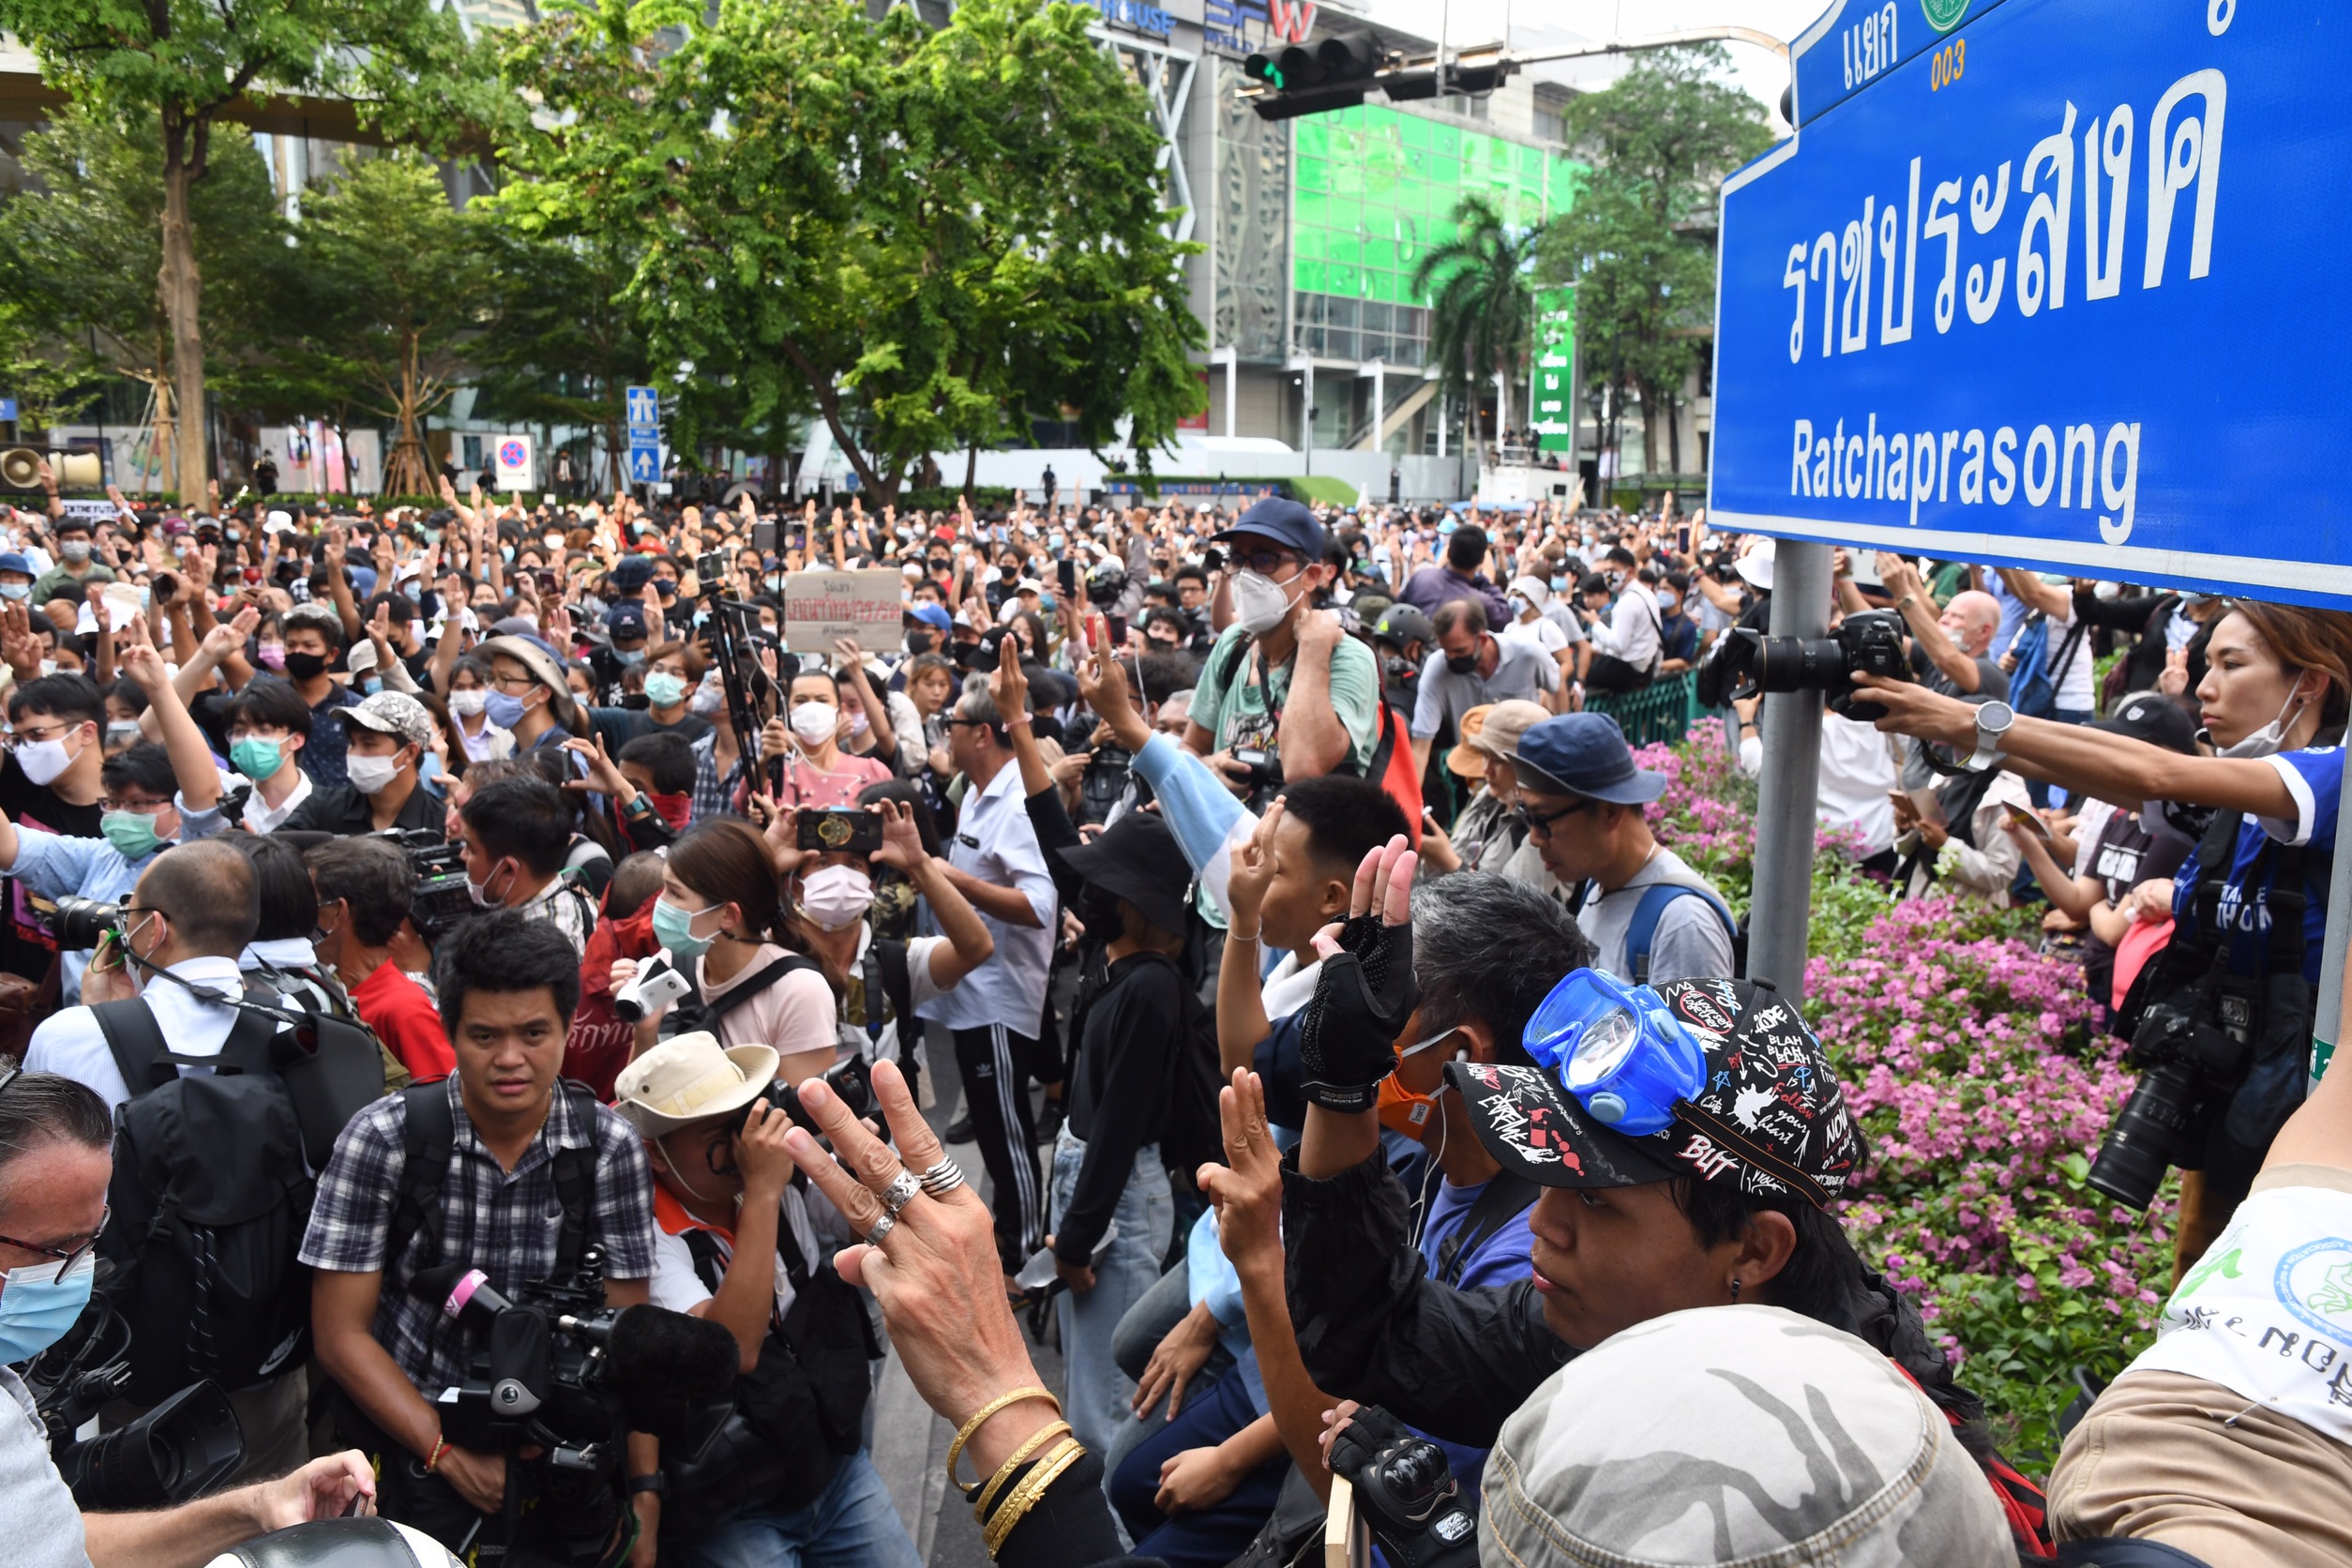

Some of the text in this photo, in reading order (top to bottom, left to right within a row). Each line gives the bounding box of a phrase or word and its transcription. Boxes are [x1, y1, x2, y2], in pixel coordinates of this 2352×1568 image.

[1844, 1, 1897, 90] แยก
[1931, 39, 1966, 92] 003
[1790, 413, 2140, 546] Ratchaprasong
[1767, 1045, 1802, 1056] BLAH
[1768, 1034, 1802, 1046] BLAH
[1776, 1054, 1811, 1064] BLAH
[1555, 1102, 1583, 1136] Remember
[1756, 1114, 1795, 1145] heart
[1826, 1105, 1848, 1150] NOW
[1674, 1134, 1741, 1182] BUT
